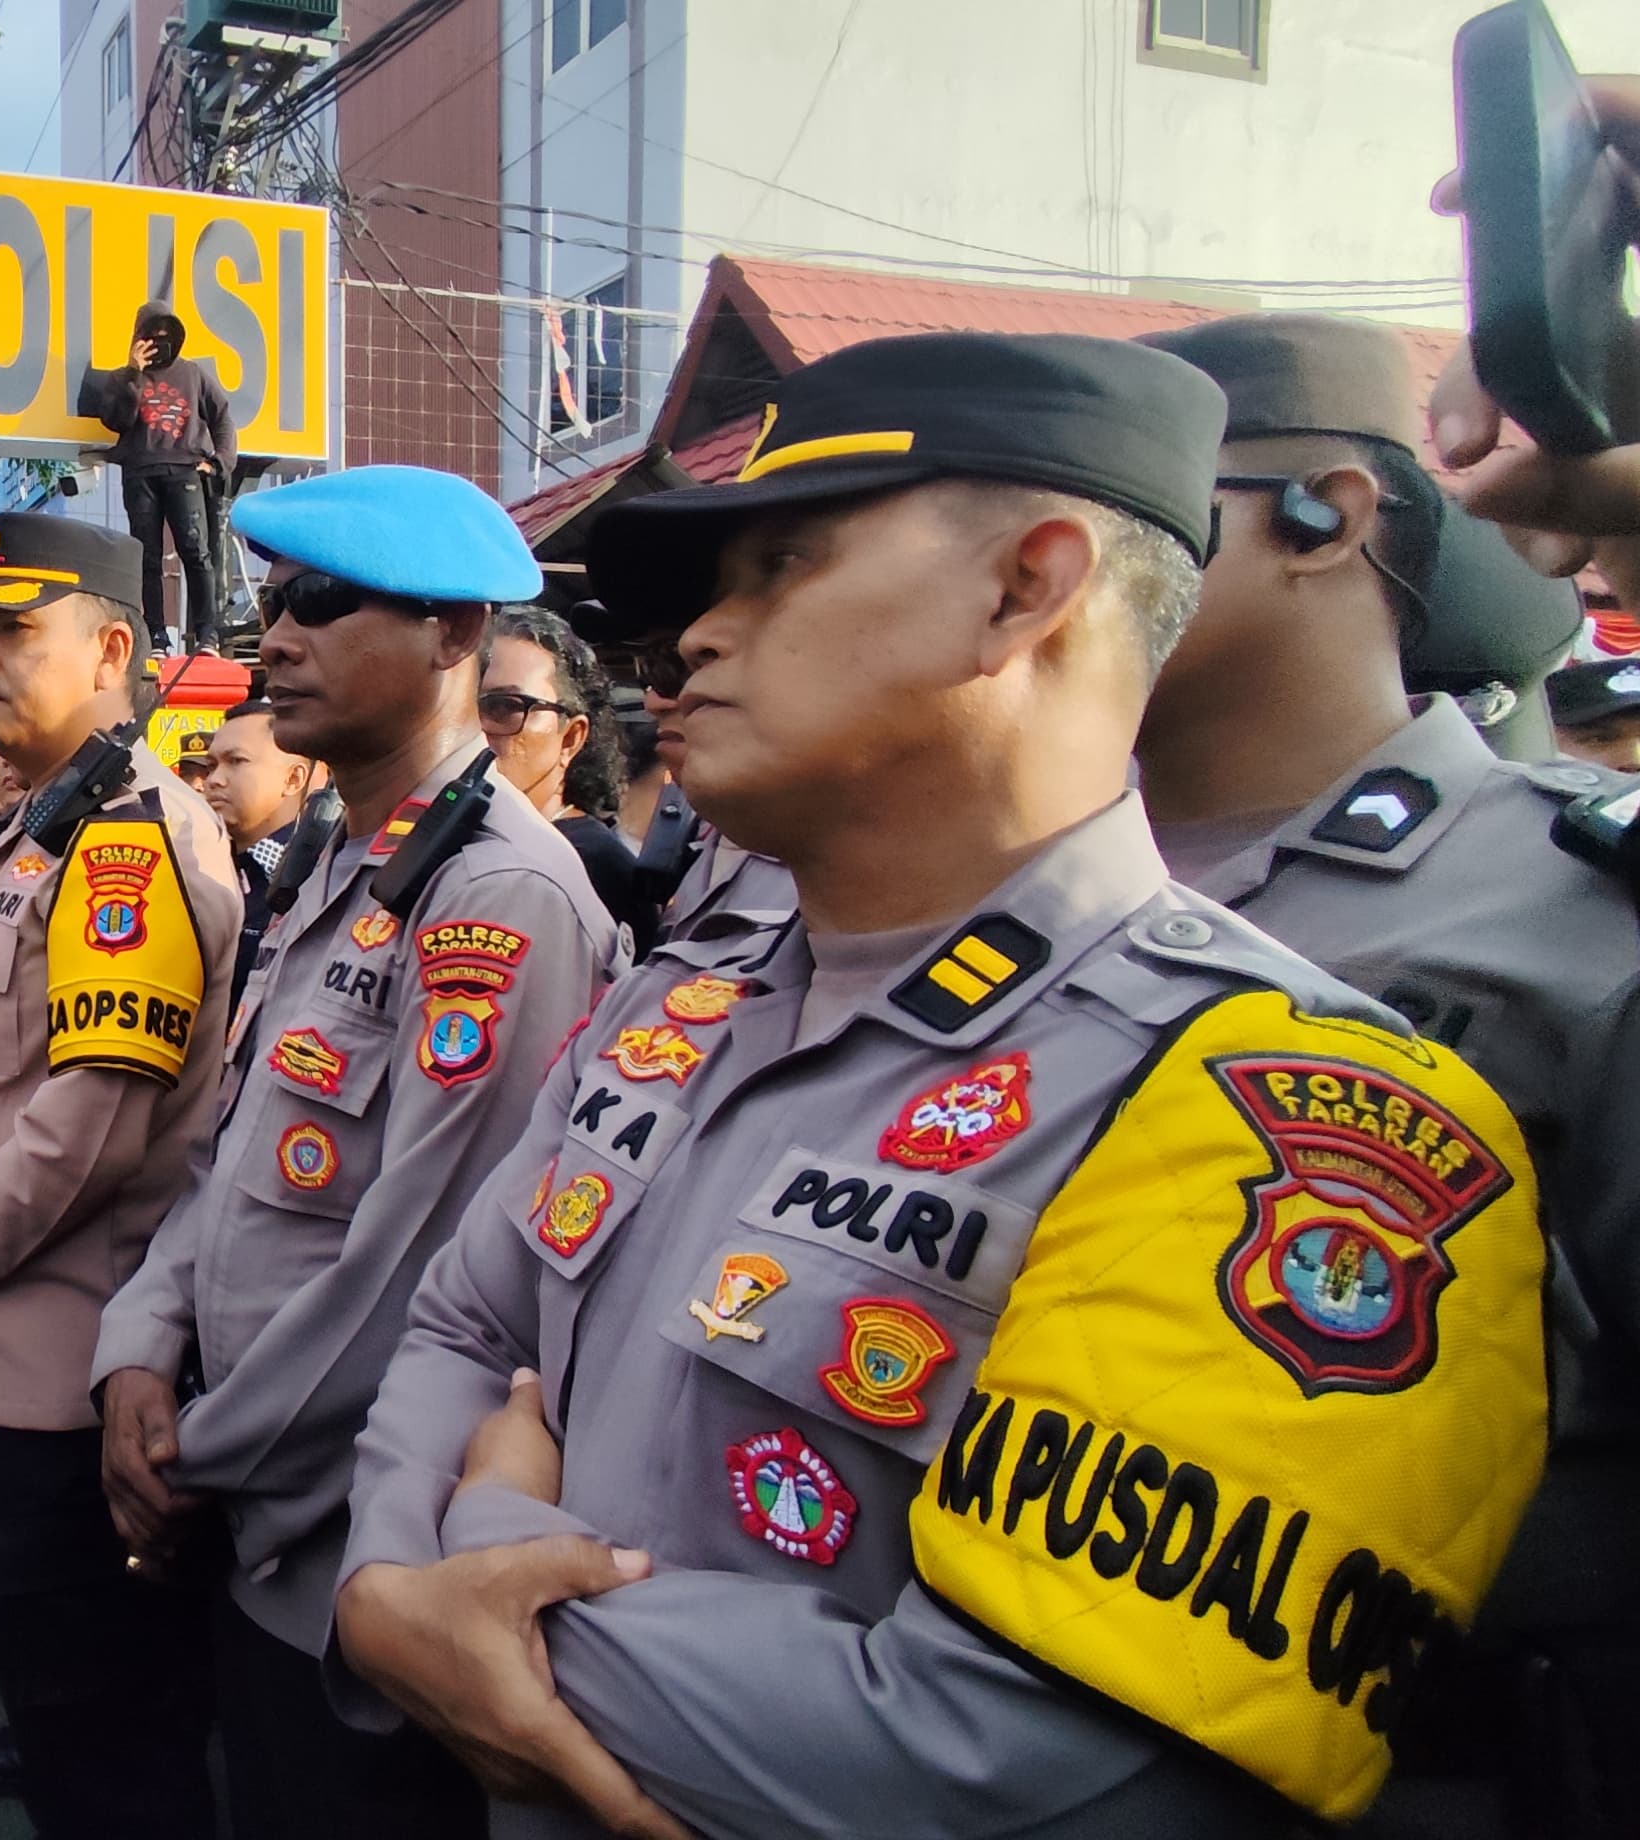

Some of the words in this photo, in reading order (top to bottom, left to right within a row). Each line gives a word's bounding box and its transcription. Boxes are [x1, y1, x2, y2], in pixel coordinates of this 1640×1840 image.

[159, 713, 226, 732] MASU
[89, 846, 153, 862] POLRES
[422, 926, 521, 951] POLRES
[429, 940, 511, 958] TARAKAN
[324, 956, 395, 1010] OLRI
[74, 990, 139, 1031] OPS
[145, 996, 191, 1049] RES
[572, 1086, 657, 1161] KA
[1265, 1071, 1472, 1170] POLRES
[1279, 1096, 1453, 1180] TARAKAN
[772, 1169, 988, 1281] POLRI
